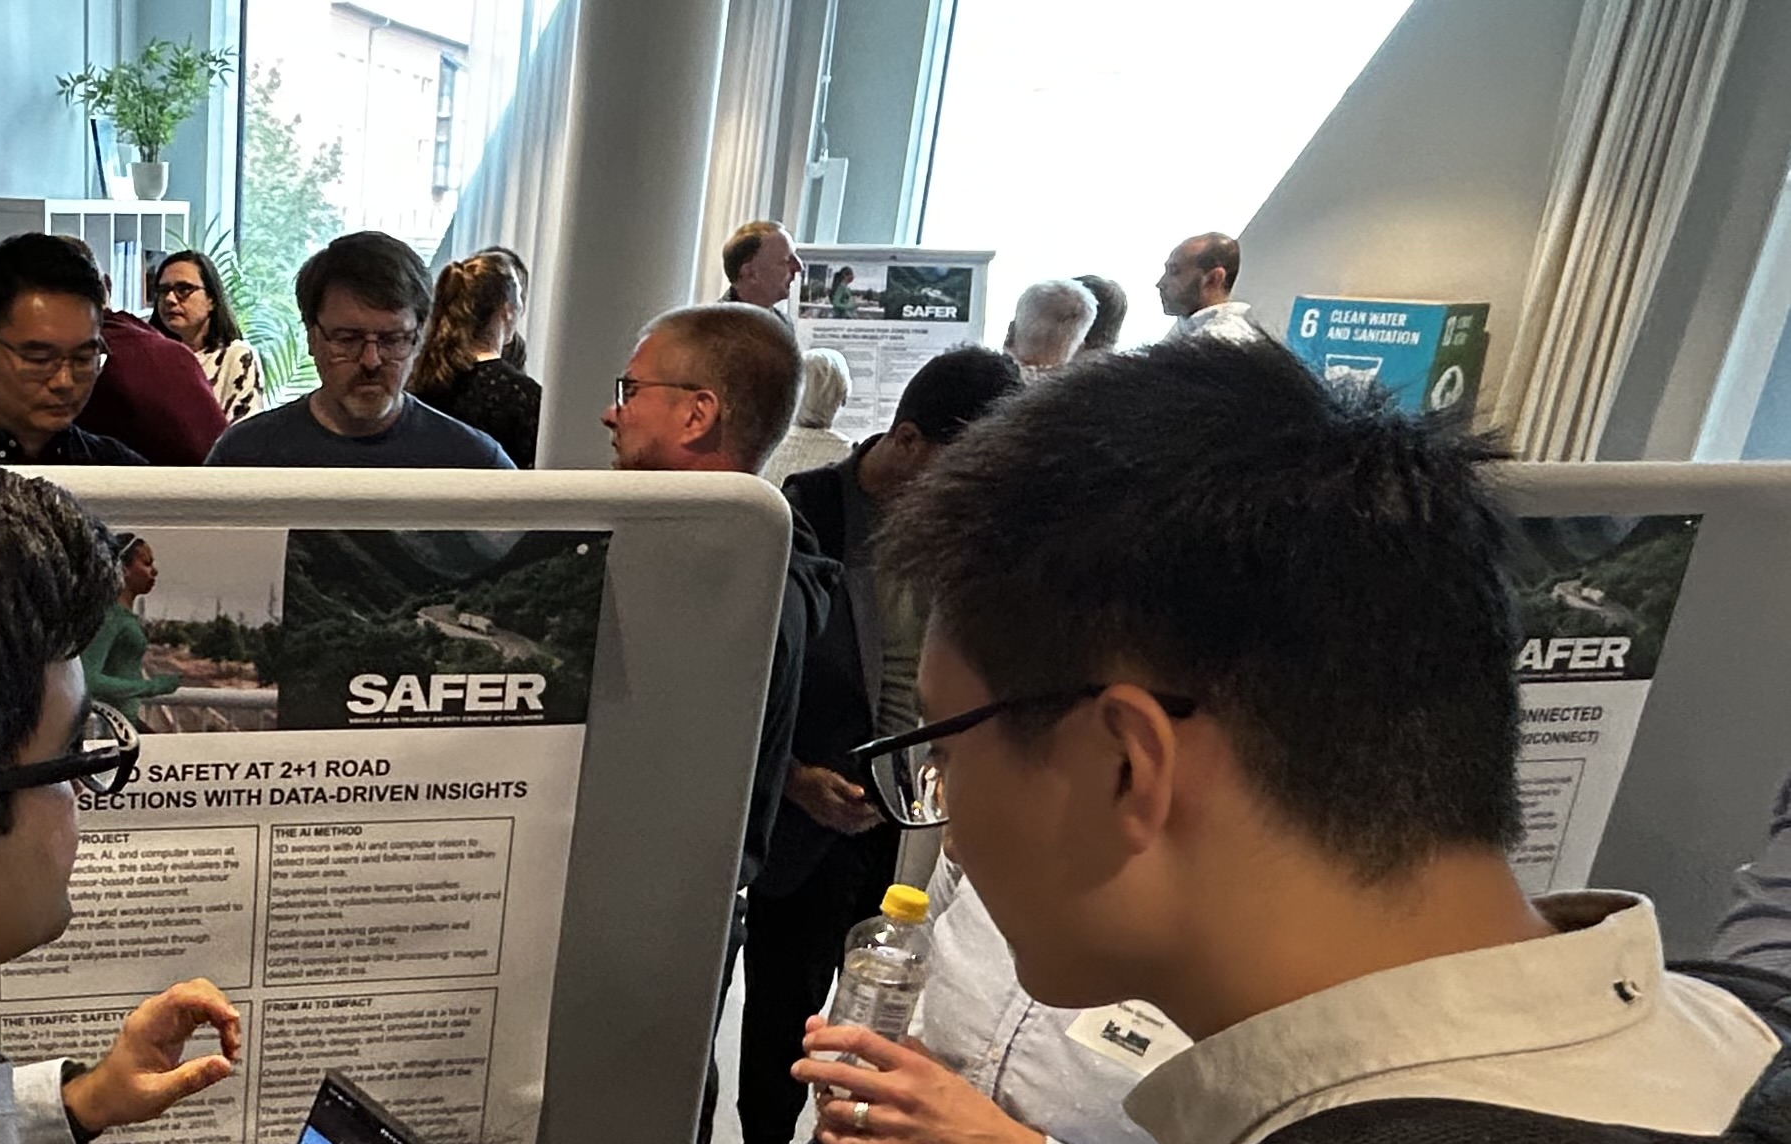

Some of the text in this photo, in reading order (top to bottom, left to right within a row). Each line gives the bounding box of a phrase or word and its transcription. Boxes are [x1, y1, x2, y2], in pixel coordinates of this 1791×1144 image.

[902, 305, 958, 318] SAFER
[1300, 308, 1407, 338] 6 CLEAN WATER
[1327, 327, 1420, 345] AND SANITATION
[1515, 636, 1631, 670] AFER
[346, 673, 547, 714] SAFER
[1520, 706, 1603, 723] NNECTED
[1521, 730, 1599, 745] 2CONNECT)
[148, 763, 241, 783] SAFETY
[245, 762, 274, 779] AT
[280, 761, 316, 779] 2+1
[325, 759, 390, 777] ROAD
[77, 781, 528, 811] SECTIONS WITH DATA-DRIVEN INSIGHTS
[275, 826, 362, 838] THE AI METHOD
[3, 1012, 126, 1027] THE TRAFFIC SAFETY
